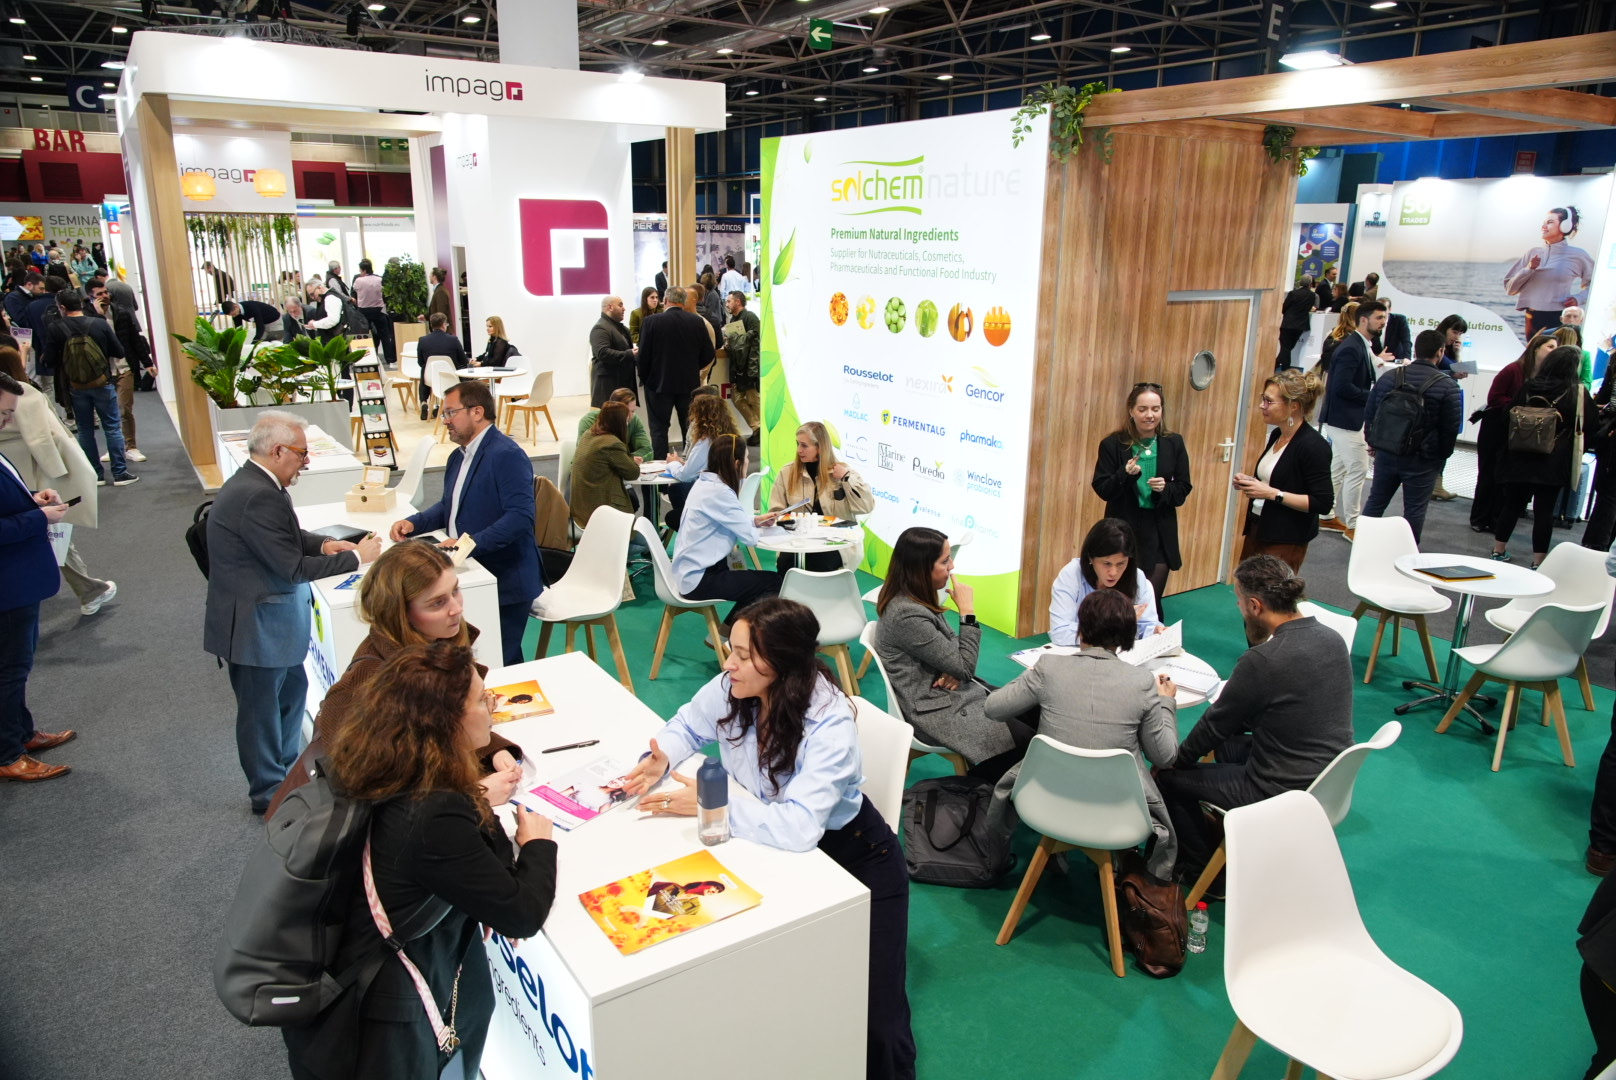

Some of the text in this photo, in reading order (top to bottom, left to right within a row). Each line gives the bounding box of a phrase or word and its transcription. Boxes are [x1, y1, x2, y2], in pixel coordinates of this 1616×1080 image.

[1268, 4, 1285, 41] E
[425, 69, 504, 101] impag
[76, 86, 97, 109] C
[33, 129, 87, 152] BAR
[49, 215, 101, 226] SEMINA
[51, 226, 102, 238] THEATR
[831, 227, 959, 244] Premium Natural Ingredients
[830, 247, 965, 264] Supplier for Nutraceuticals, Cosmetics,
[830, 262, 997, 285] Pharmaceuticals and Functional Food Industry
[1467, 321, 1503, 332] lutions
[843, 364, 894, 383] Rousselot
[965, 384, 1005, 403] Gencor
[892, 416, 946, 437] FERMENTALG
[880, 444, 906, 463] Marine
[881, 456, 894, 469] Bio
[912, 457, 945, 480] Puredia
[967, 470, 1002, 488] Winclove
[871, 487, 900, 503] EuroCaps
[966, 482, 1001, 498] probiotics
[488, 954, 546, 1066] ngredients
[492, 931, 594, 1080] selot
